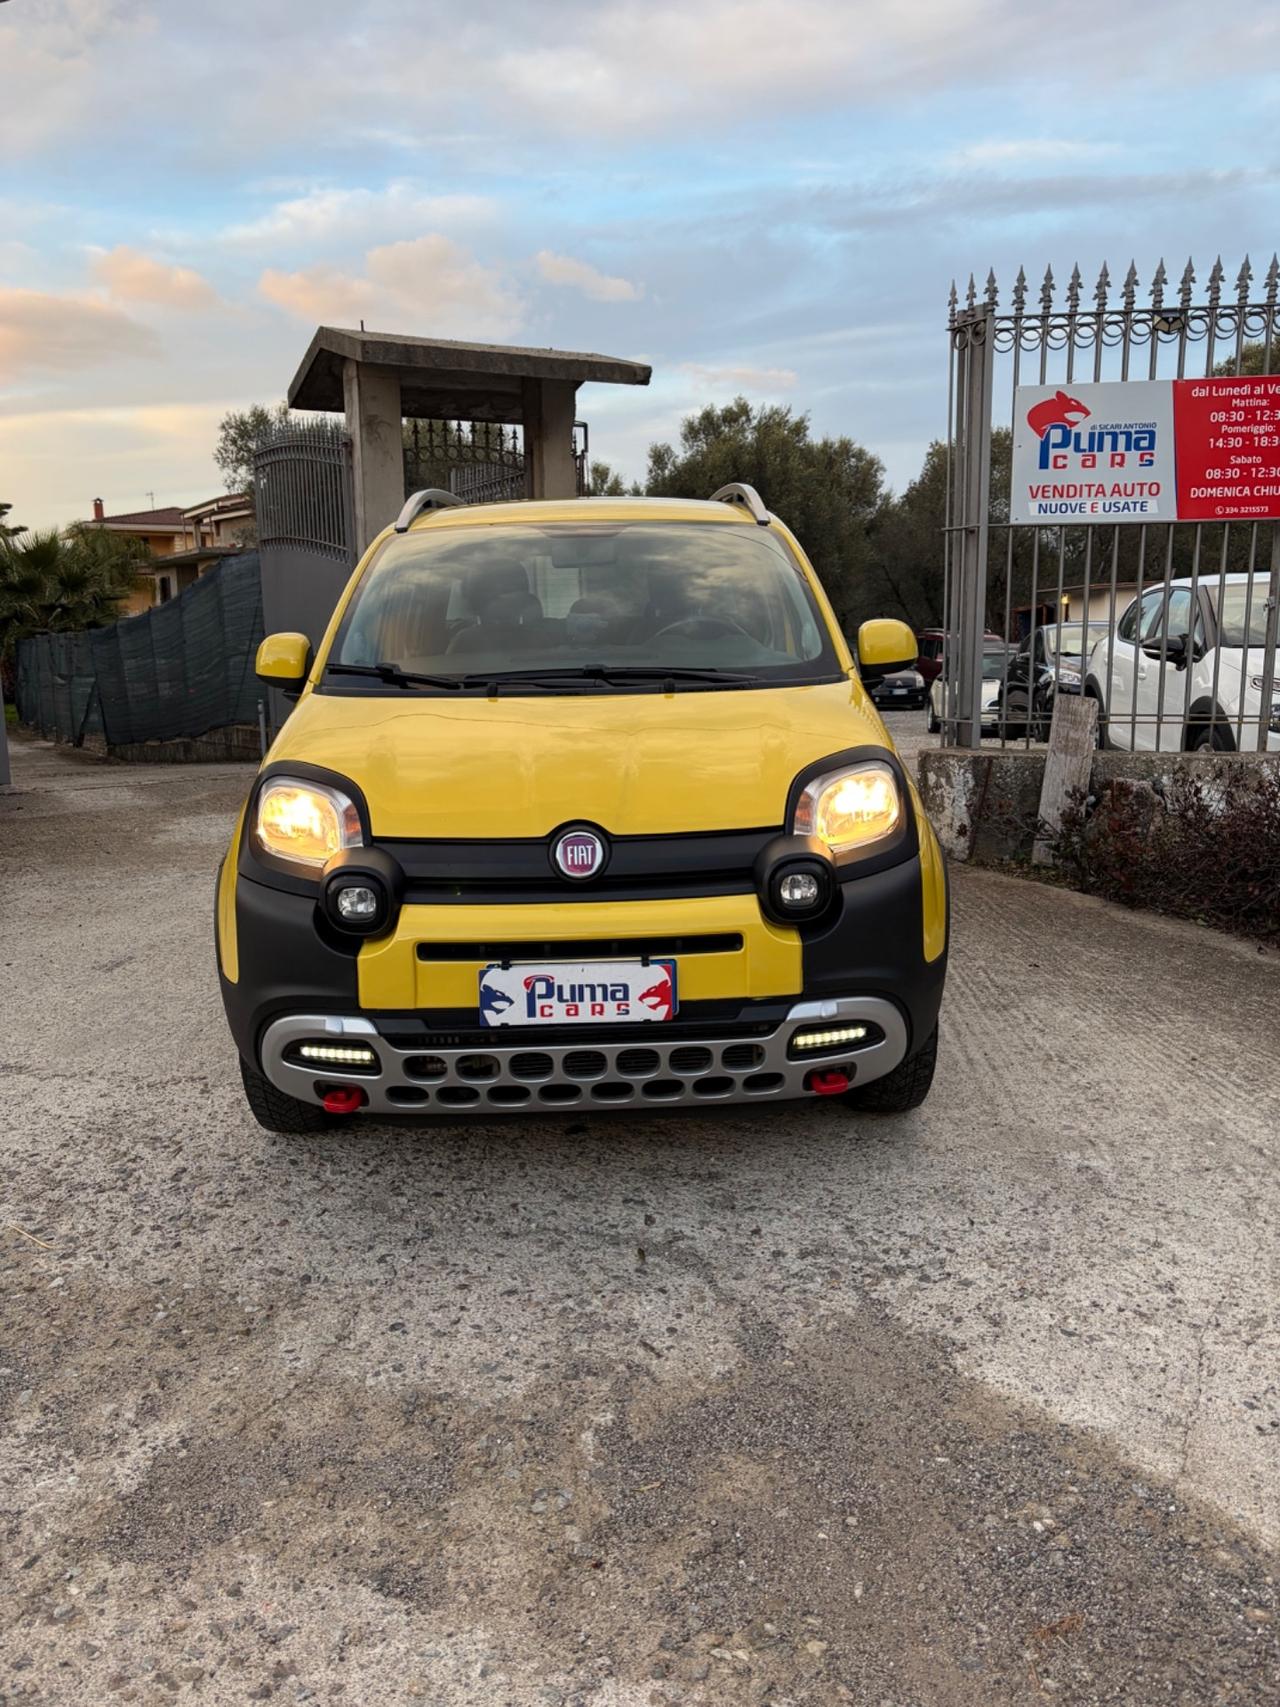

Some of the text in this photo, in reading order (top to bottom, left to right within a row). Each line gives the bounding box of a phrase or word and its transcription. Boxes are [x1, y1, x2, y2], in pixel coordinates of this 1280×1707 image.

[1191, 386, 1209, 397] dal
[1212, 384, 1251, 397] Lunedì
[1253, 383, 1264, 395] al
[1232, 397, 1270, 407] Mattina:
[1210, 411, 1245, 423] 08:30
[1123, 422, 1157, 430] ANTONIO
[1221, 423, 1276, 435] Pomeriggio:
[1039, 424, 1155, 469] Puma
[1209, 437, 1243, 449] 14:30
[1253, 436, 1280, 447] 18:3
[1230, 455, 1262, 465] Sabato
[1205, 468, 1240, 480] 08:30
[1028, 482, 1161, 499] VENDITA AUTO
[1190, 486, 1251, 498] DOMENICA
[1037, 500, 1149, 514] NUOVE E USATE
[566, 845, 594, 866] FIAT
[526, 976, 630, 1018] Puma
